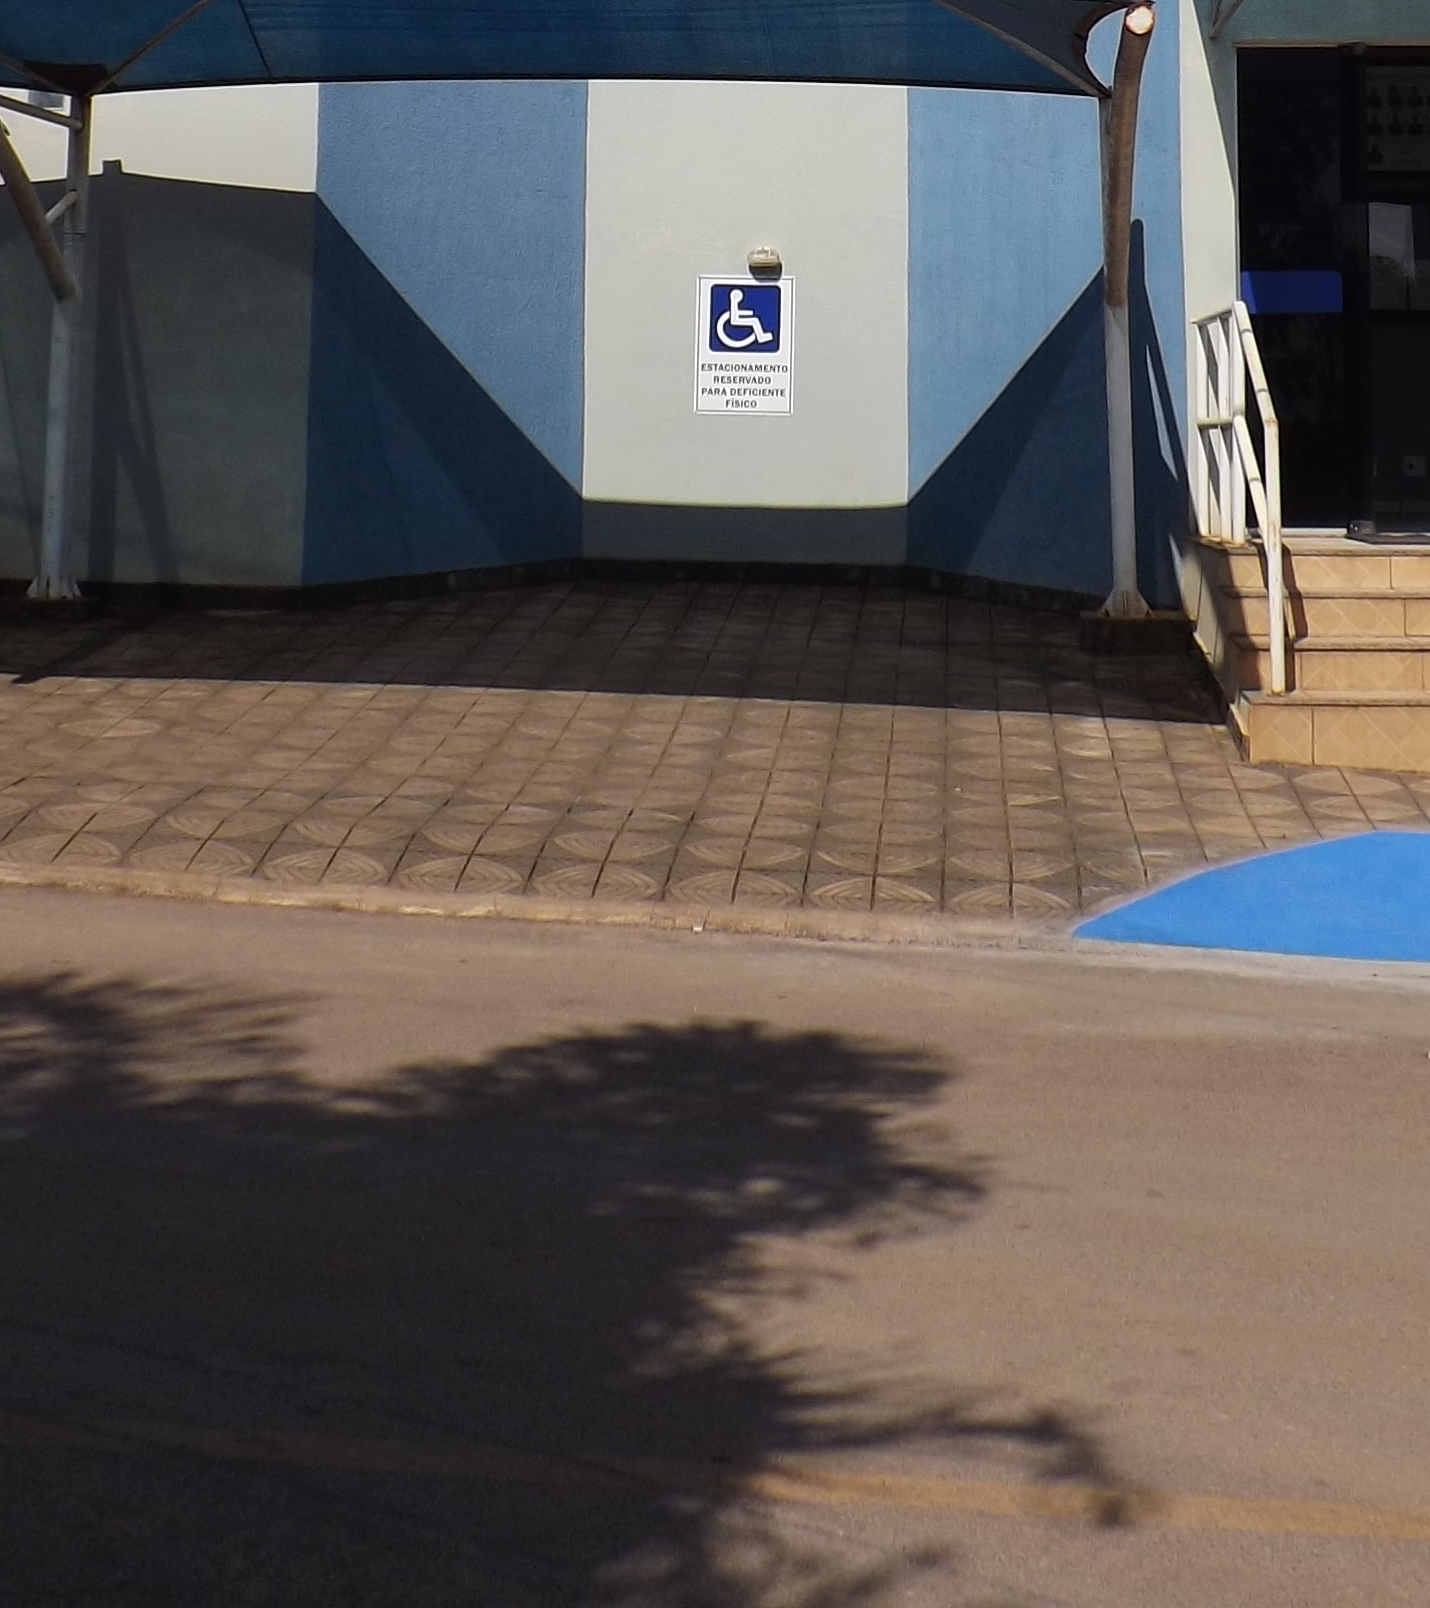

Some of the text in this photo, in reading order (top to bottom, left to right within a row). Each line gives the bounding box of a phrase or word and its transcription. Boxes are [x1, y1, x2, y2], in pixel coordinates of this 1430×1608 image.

[701, 363, 788, 374] ESTACIONAMENTO
[713, 376, 771, 385] RESERVADO
[701, 387, 786, 397] PARA DEFICIENTE
[725, 397, 757, 408] FÍSICO
